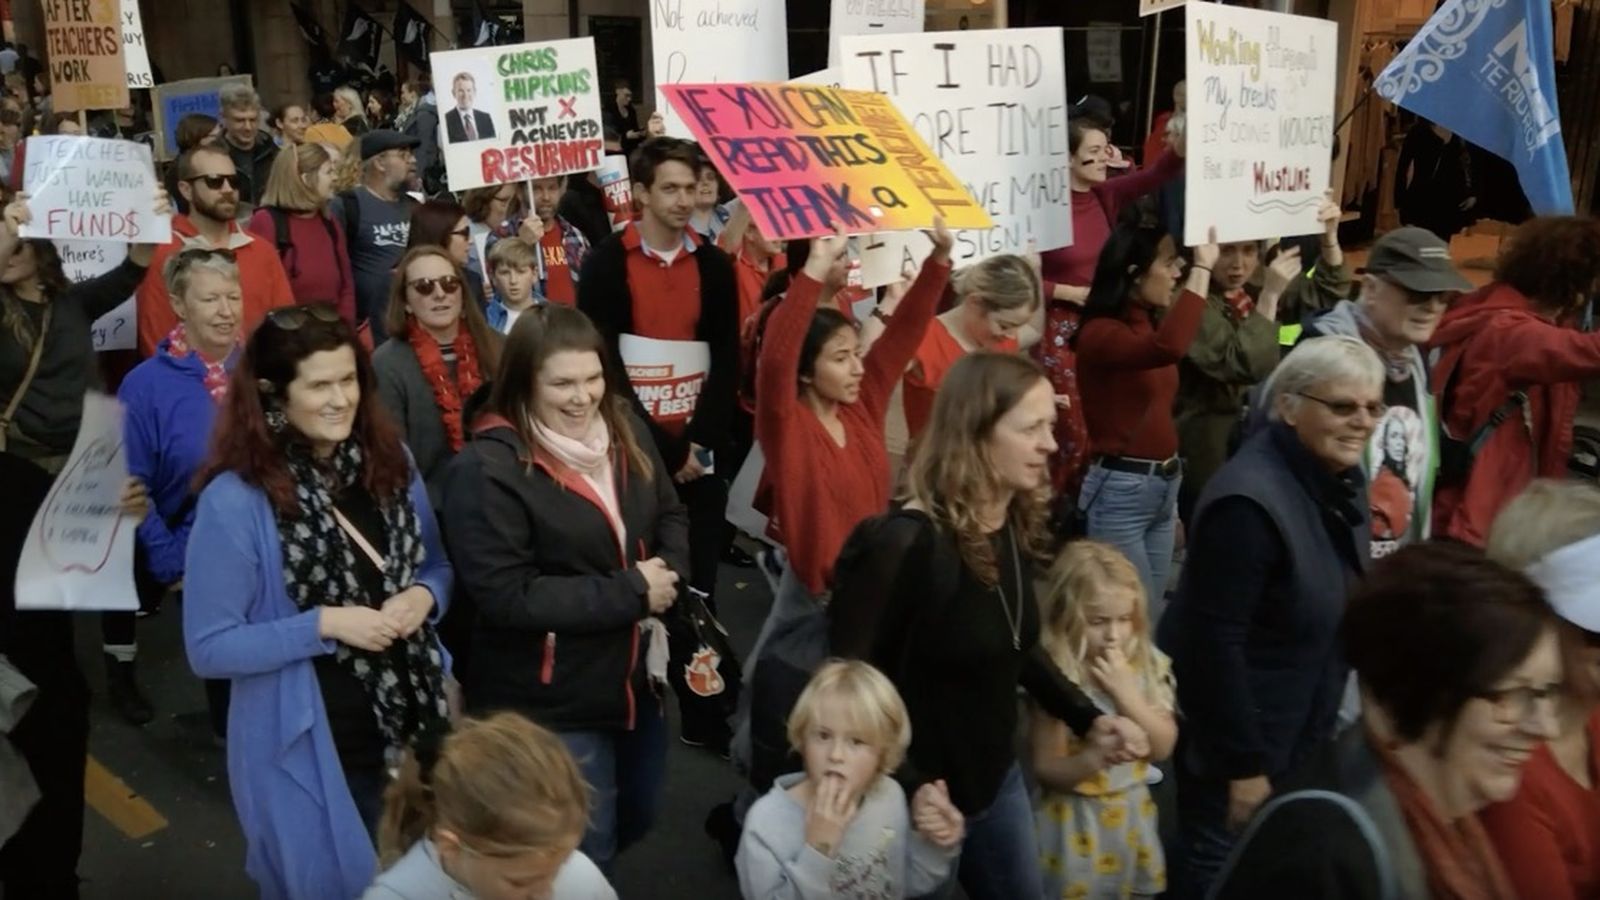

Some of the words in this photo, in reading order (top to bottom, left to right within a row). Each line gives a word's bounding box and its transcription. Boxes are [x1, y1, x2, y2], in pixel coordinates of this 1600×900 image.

[653, 0, 685, 31] Not
[697, 6, 759, 32] achieved
[47, 26, 118, 57] TEACHERS
[51, 59, 92, 84] WORK
[497, 47, 558, 77] CHRIS
[856, 50, 909, 97] IF
[933, 42, 960, 89] I
[987, 43, 1043, 89] HAD
[1479, 52, 1510, 87] TE
[503, 68, 591, 101] HIPKINS
[509, 106, 548, 130] NOT
[676, 88, 718, 135] IF
[717, 86, 793, 131] YOU
[779, 86, 862, 128] CAN
[511, 119, 600, 146] ACHIEVED
[912, 104, 976, 160] ORE
[986, 102, 1066, 156] TIME
[481, 139, 602, 184] RESUBMIT
[708, 135, 810, 176] READ
[795, 132, 888, 169] THIS
[26, 161, 77, 188] JUST
[86, 167, 144, 189] WANNA
[1009, 166, 1069, 216] MADE
[69, 190, 115, 208] HAVE
[900, 244, 917, 281] A
[674, 377, 703, 399] OUT
[658, 395, 698, 416] BEST
